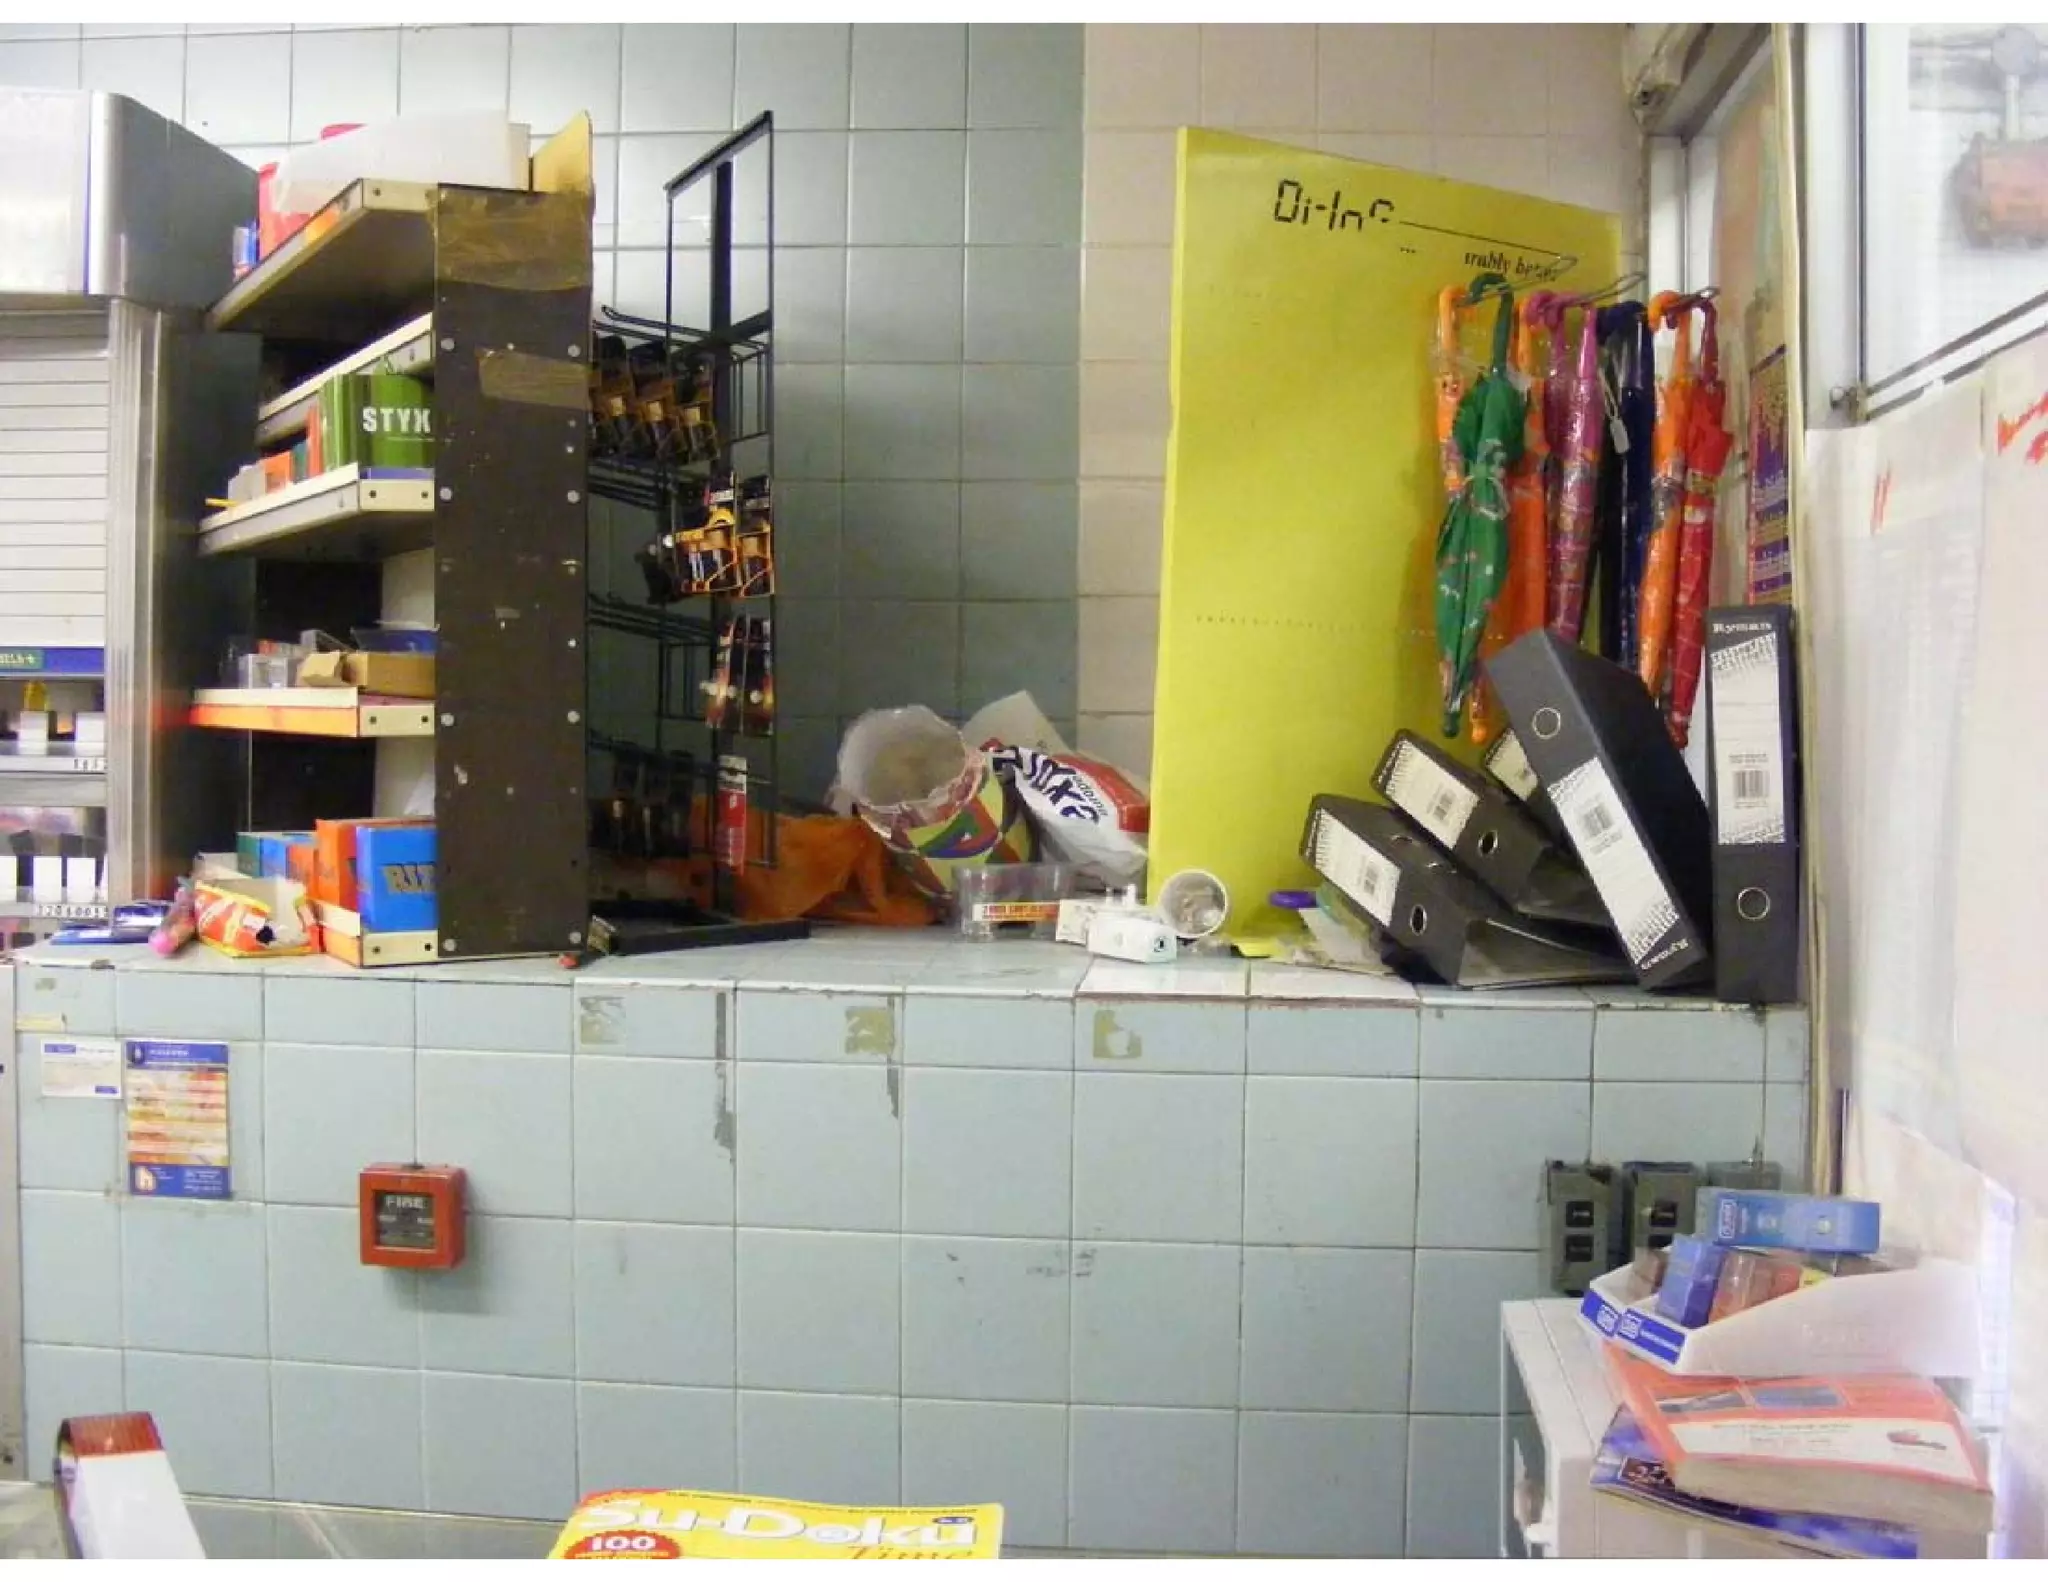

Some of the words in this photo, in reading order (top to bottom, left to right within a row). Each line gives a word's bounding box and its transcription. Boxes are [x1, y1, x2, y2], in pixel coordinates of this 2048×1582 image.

[362, 407, 431, 433] STYX
[385, 1195, 423, 1209] FIRE
[592, 1536, 656, 1550] 100
